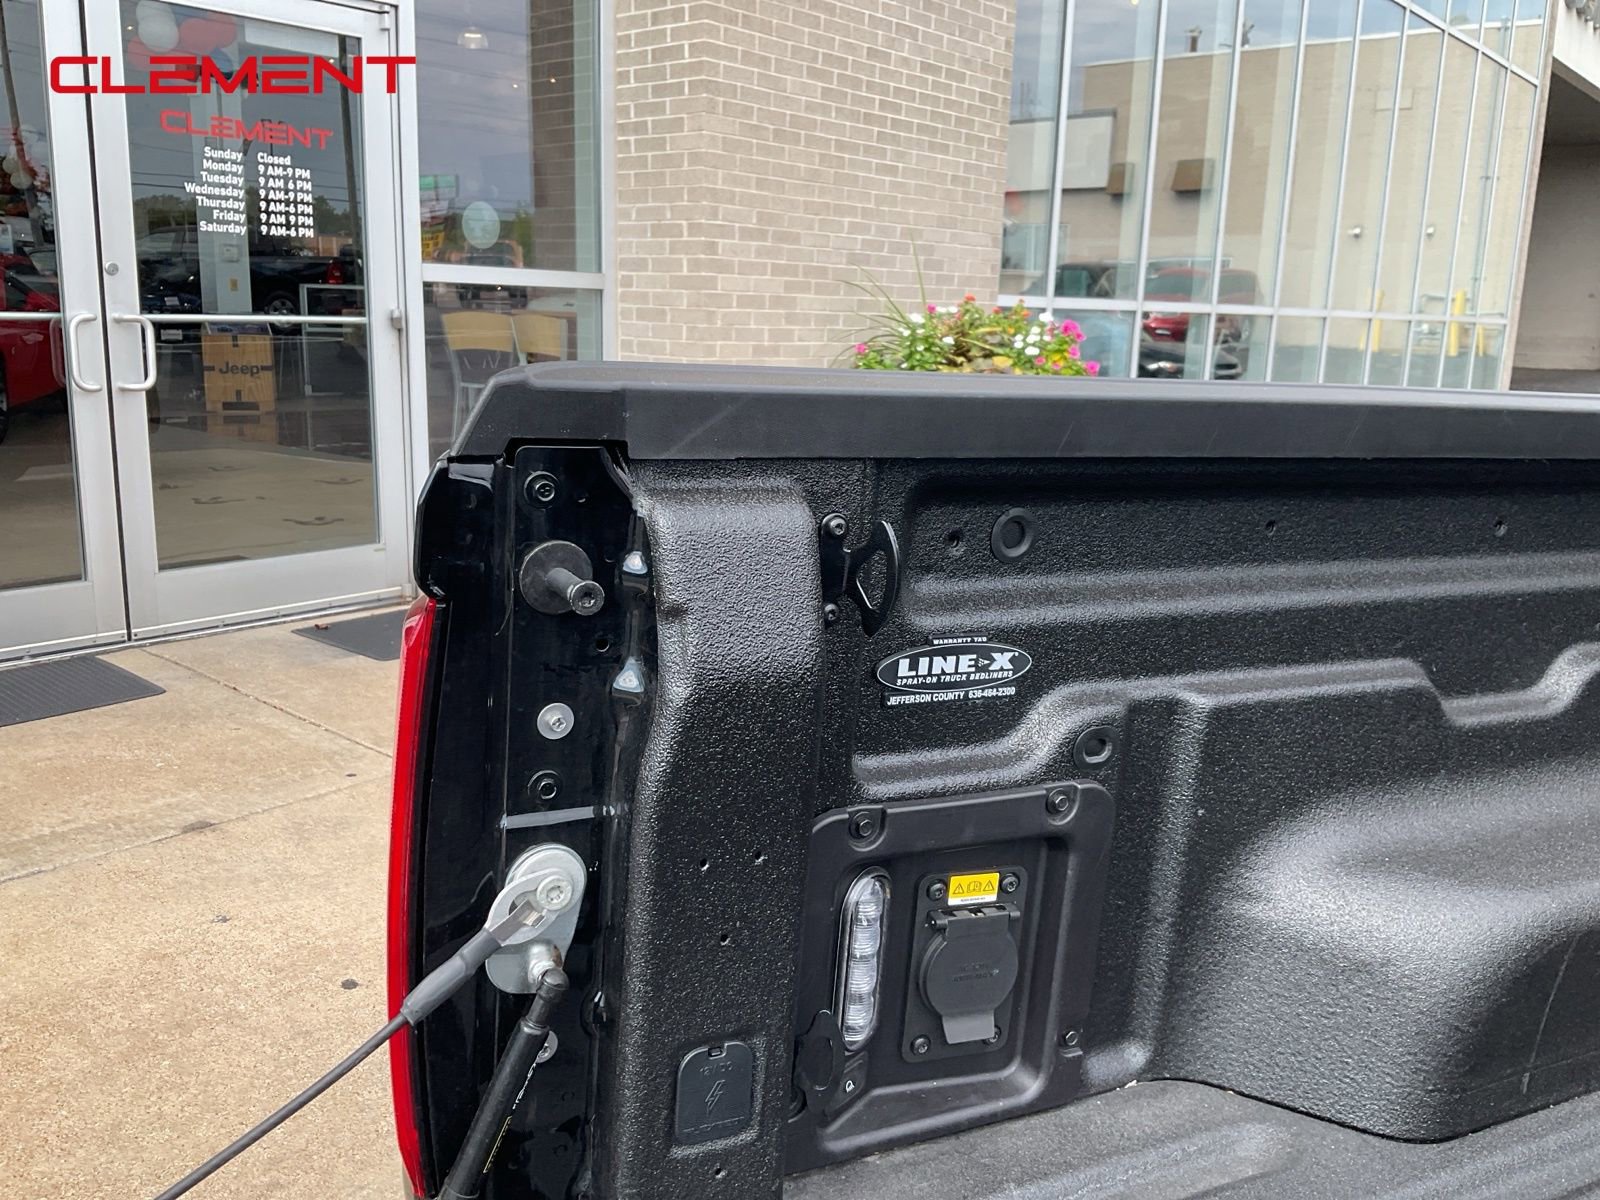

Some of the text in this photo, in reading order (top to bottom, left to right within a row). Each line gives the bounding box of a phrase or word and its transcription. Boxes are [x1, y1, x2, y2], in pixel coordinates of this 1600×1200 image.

[159, 109, 334, 151] CLEMENT
[204, 146, 291, 165] Sunday Closed
[202, 159, 244, 174] Monday
[257, 164, 265, 175] 9
[294, 168, 311, 179] PM
[200, 171, 244, 187] Tuesday
[258, 177, 265, 187] 9
[296, 180, 312, 191] PM
[184, 182, 245, 199] Wednesday
[259, 189, 266, 199] 9
[297, 192, 313, 203] PM
[196, 195, 245, 211] Thursday
[259, 201, 267, 211] 9
[297, 204, 313, 215] PM
[213, 209, 246, 223] Friday
[260, 213, 267, 223] 9
[298, 216, 314, 227] PM
[199, 221, 247, 236] Saturday
[260, 225, 268, 235] 9
[298, 228, 314, 238] PM
[218, 361, 260, 377] Jeep
[940, 674, 967, 682] TRUCK
[969, 670, 1013, 681] BEDLINERS
[886, 693, 932, 706] JEFFERSON
[932, 691, 965, 702] COUNTY
